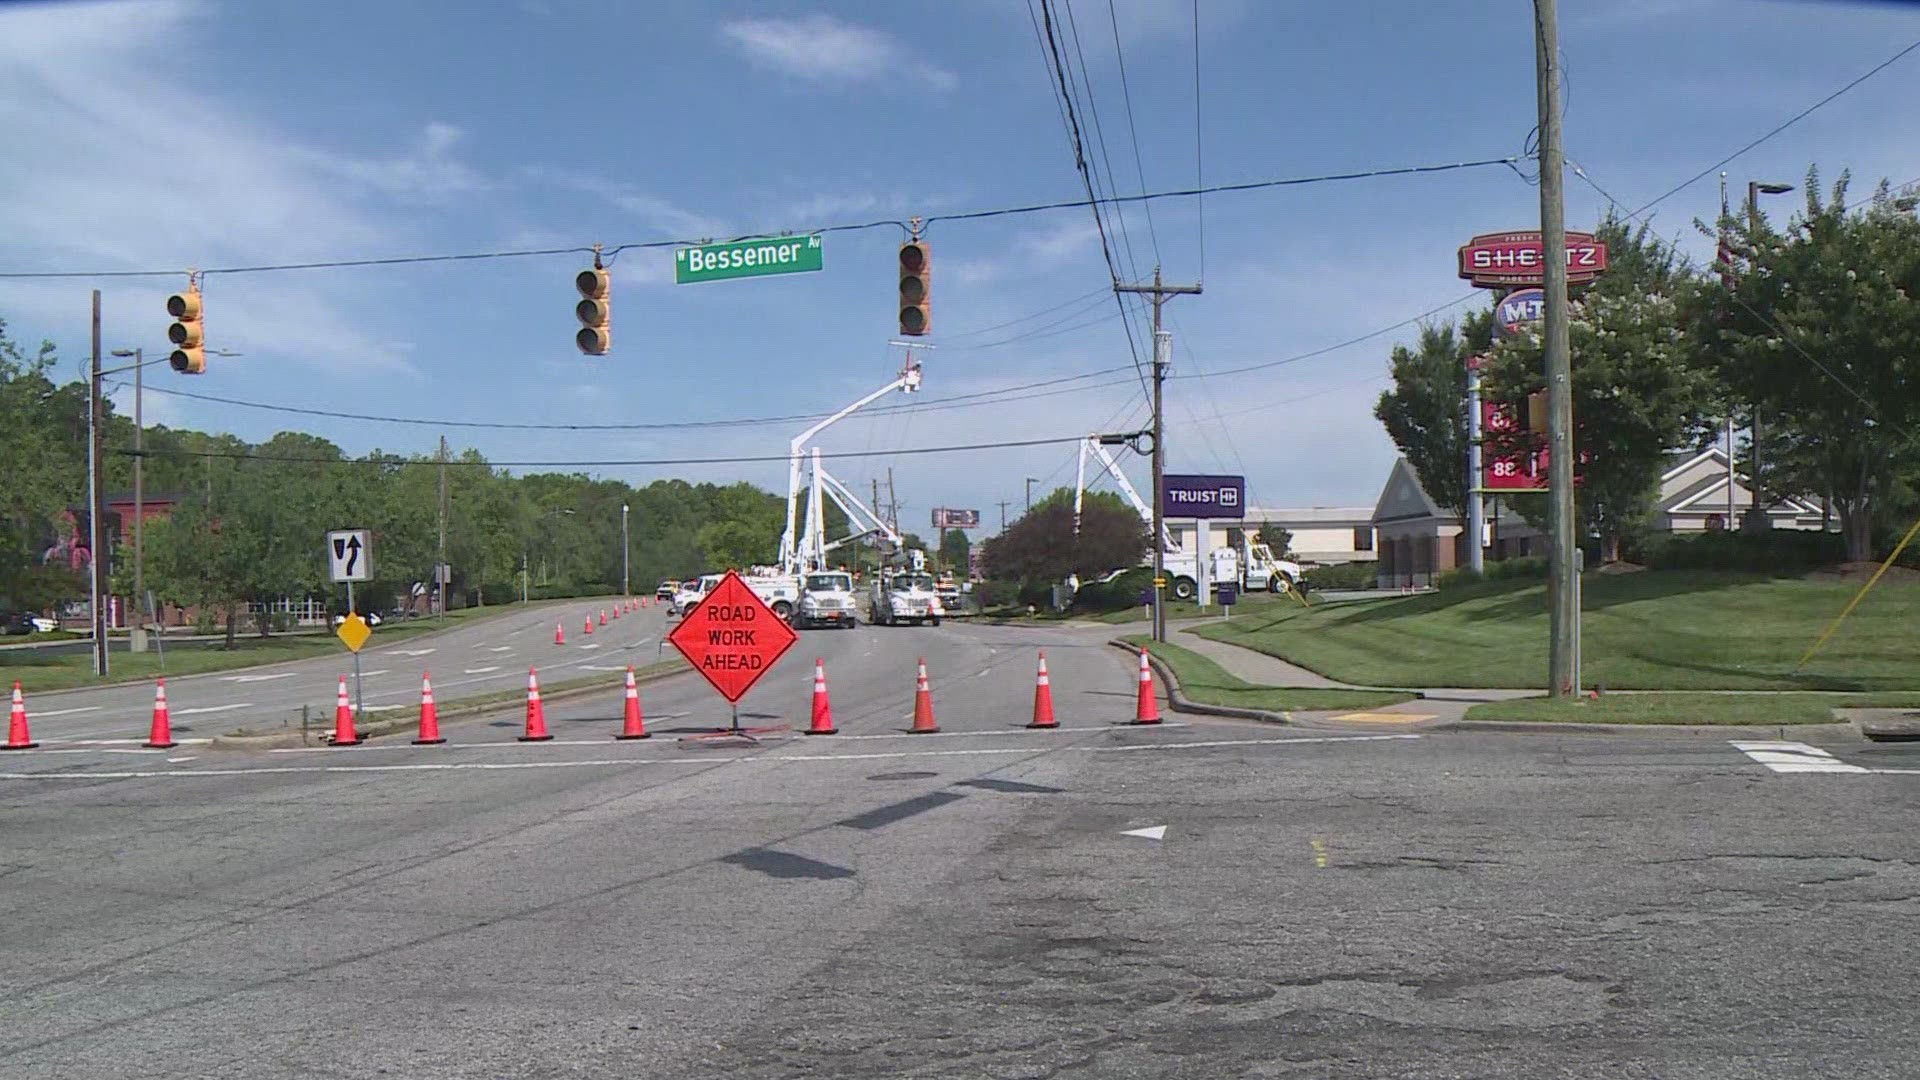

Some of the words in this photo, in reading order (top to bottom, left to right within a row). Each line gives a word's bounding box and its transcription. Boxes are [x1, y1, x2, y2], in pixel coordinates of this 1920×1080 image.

[677, 251, 685, 261] W
[690, 244, 801, 271] Bessemer
[808, 237, 821, 248] Av
[1474, 248, 1596, 267] SHETZ
[1170, 490, 1218, 502] TRUIST
[708, 606, 755, 621] ROAD
[708, 630, 755, 646] WORK
[703, 654, 761, 670] AHEAD
